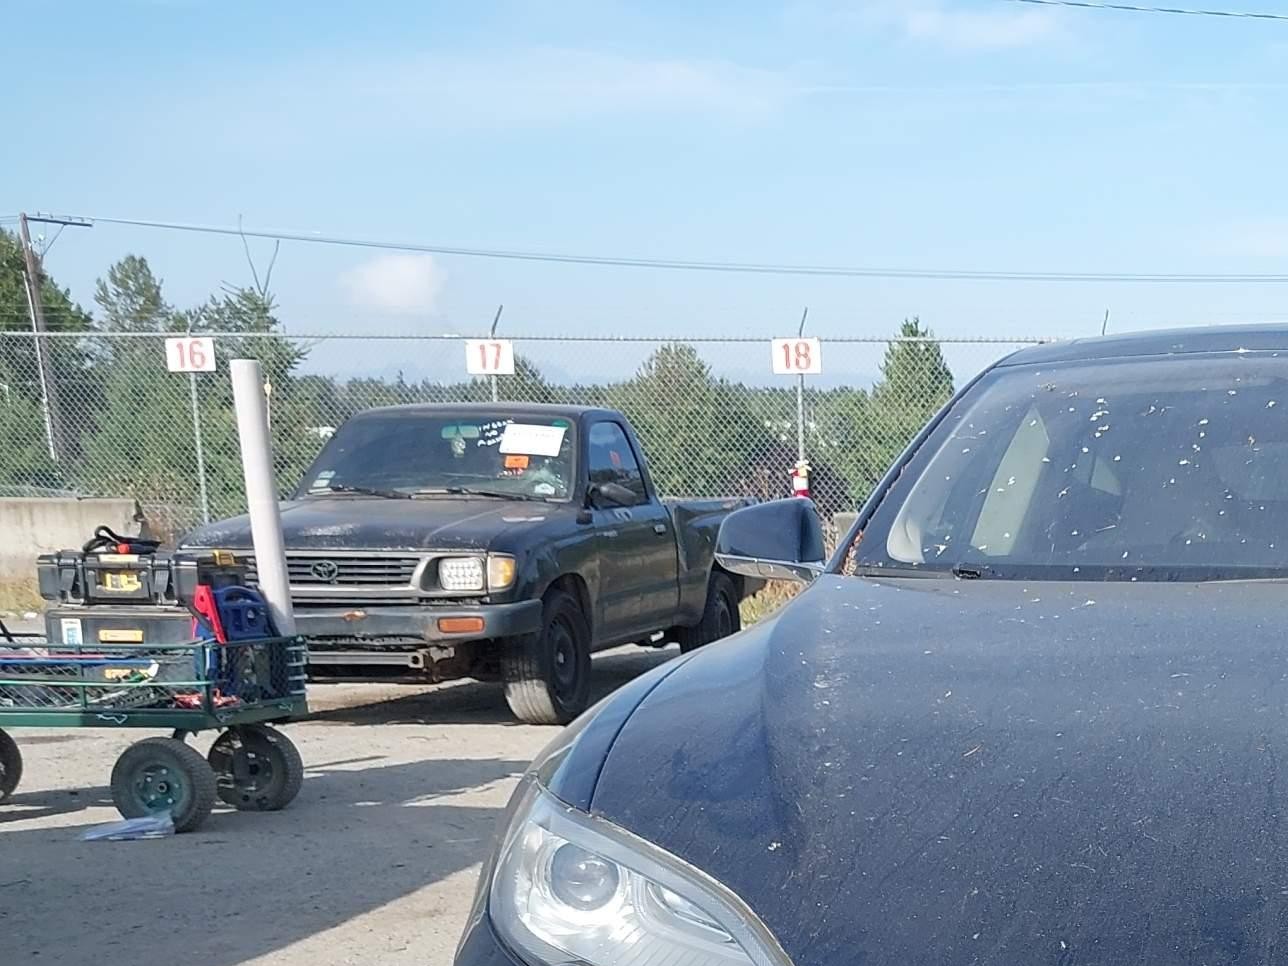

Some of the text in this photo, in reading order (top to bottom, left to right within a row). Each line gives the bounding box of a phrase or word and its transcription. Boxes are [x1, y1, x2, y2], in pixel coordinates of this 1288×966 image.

[176, 341, 206, 369] 16
[480, 344, 501, 370] 17
[782, 342, 811, 370] 18
